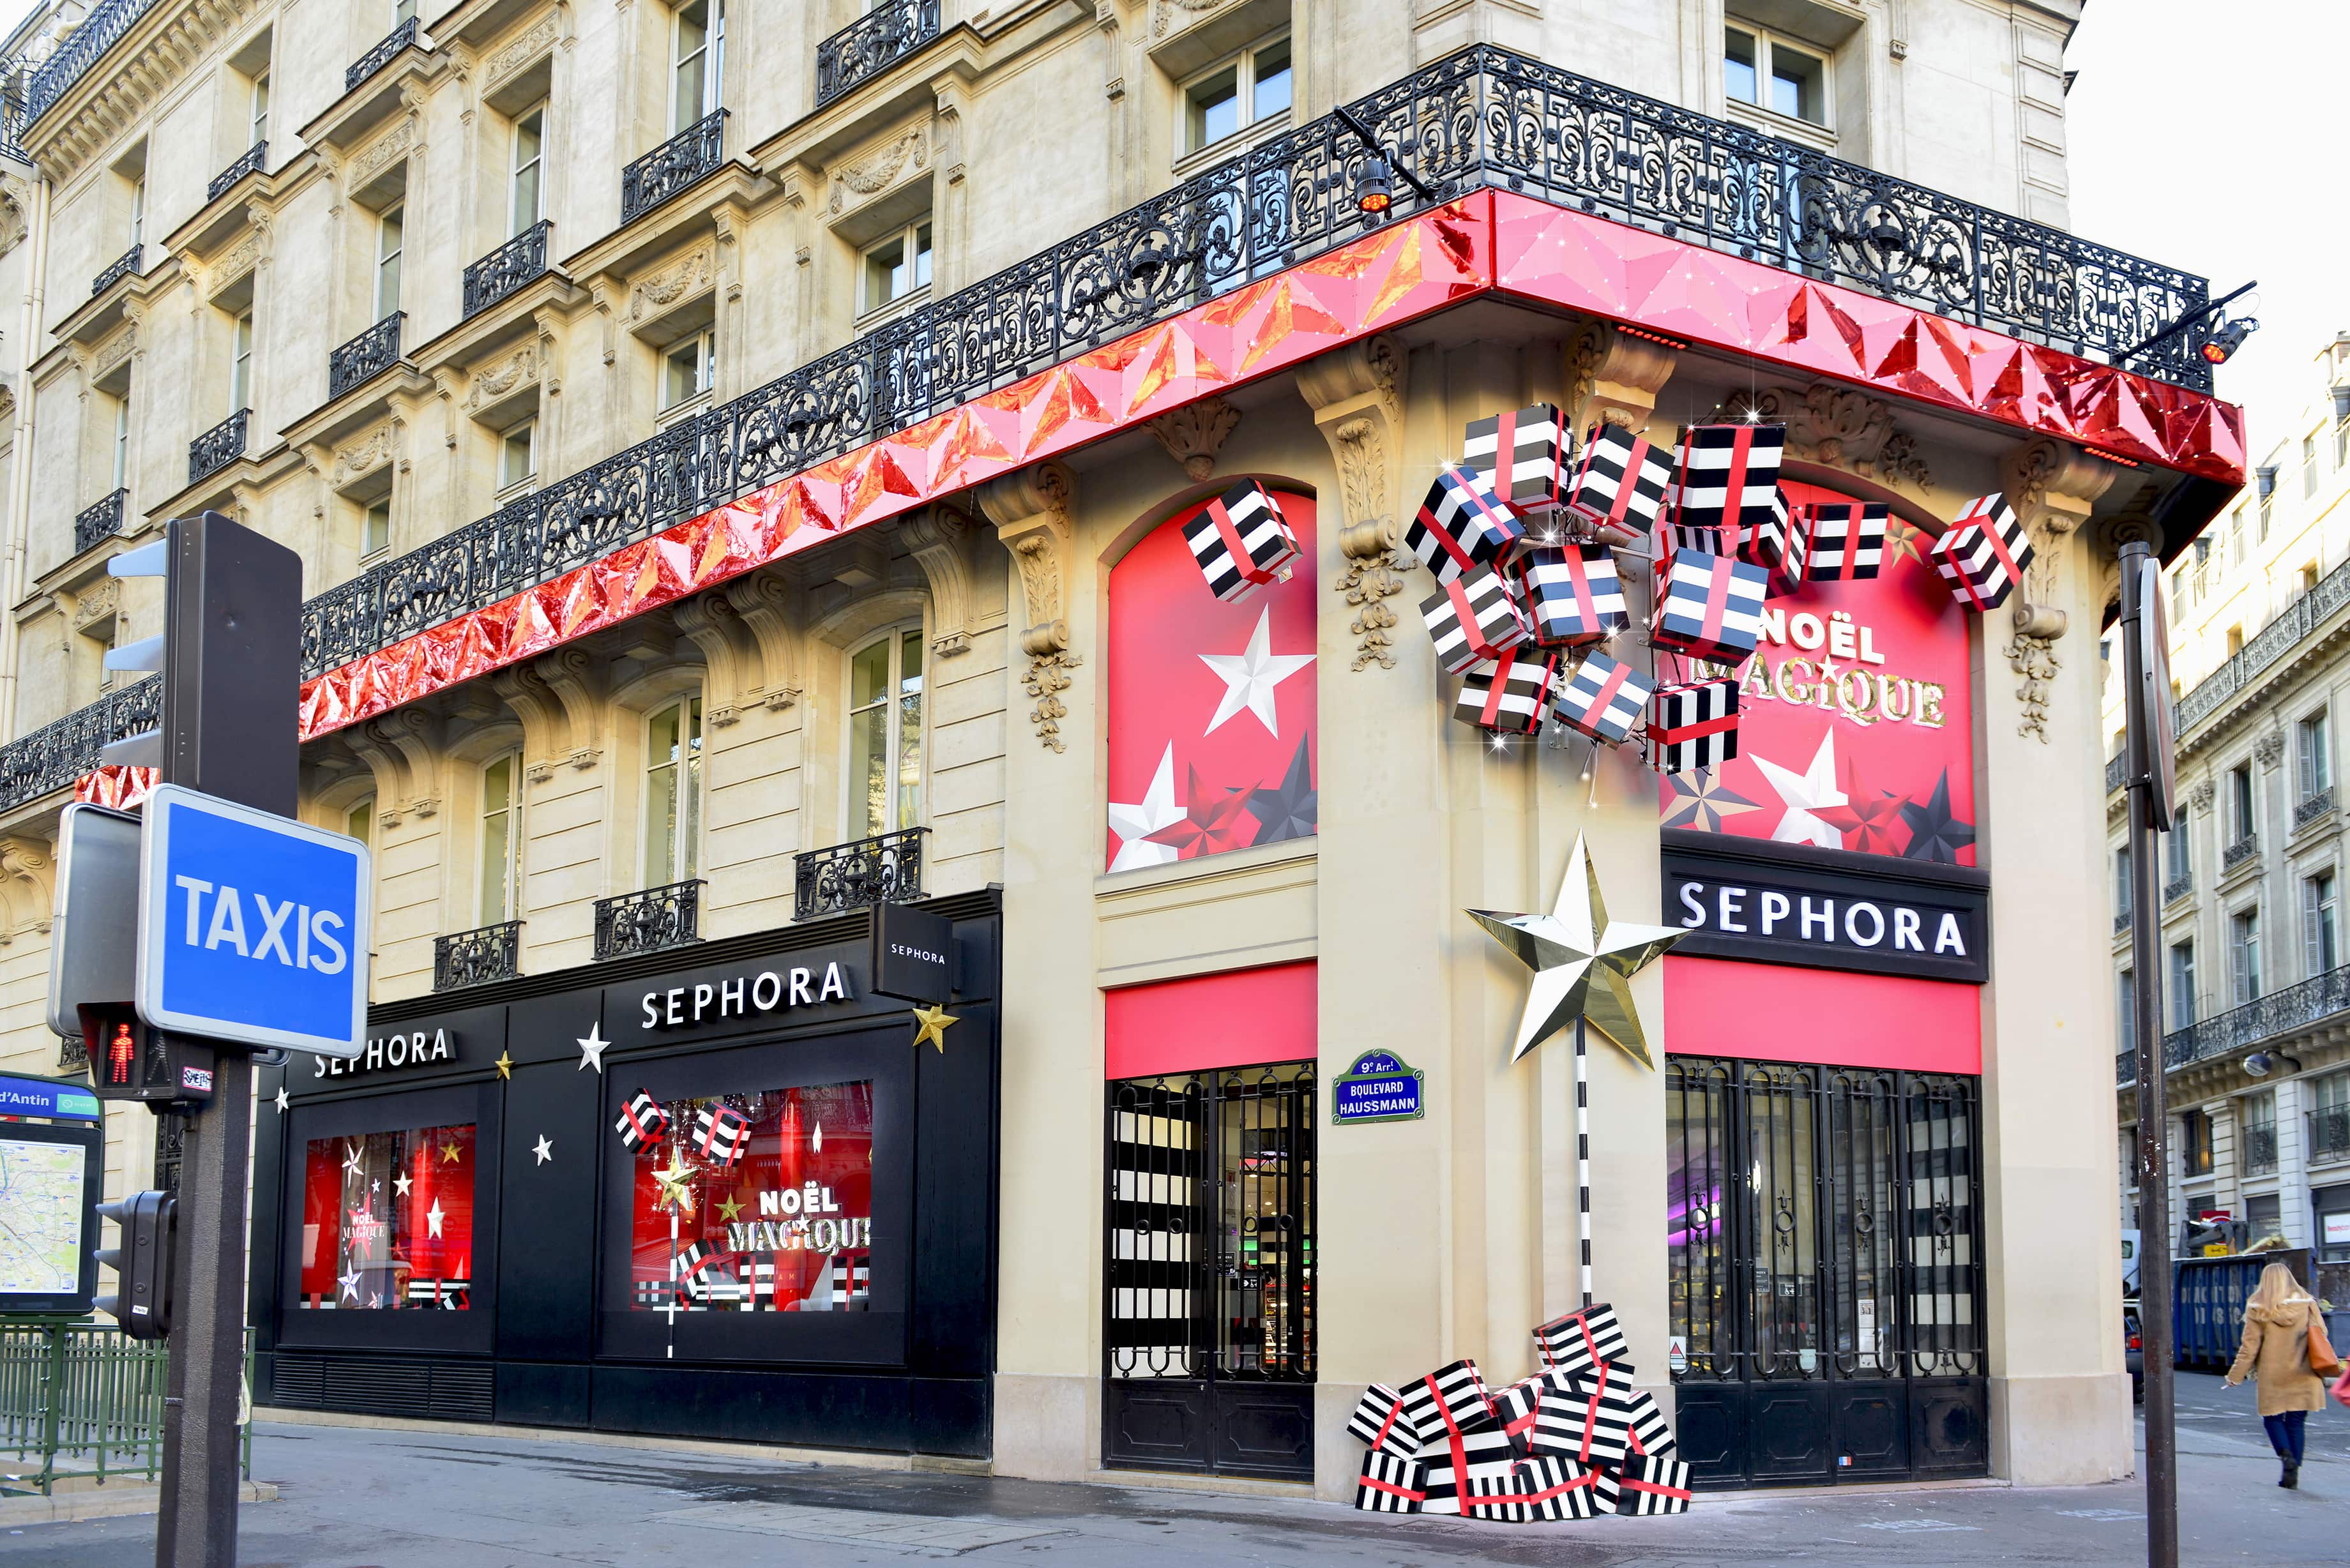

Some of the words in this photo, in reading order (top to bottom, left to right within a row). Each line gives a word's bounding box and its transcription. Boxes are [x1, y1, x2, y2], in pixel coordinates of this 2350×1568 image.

[176, 874, 347, 976] TAXIS
[1679, 882, 1966, 956] SEPHORA
[891, 943, 945, 965] SEPHORA
[641, 961, 845, 1029] SEPHORA
[1351, 1081, 1404, 1098] BOULEVARD
[1340, 1098, 1415, 1114] HAUSSMANN
[760, 1180, 838, 1216] NOËL
[352, 1211, 375, 1225] NOËL
